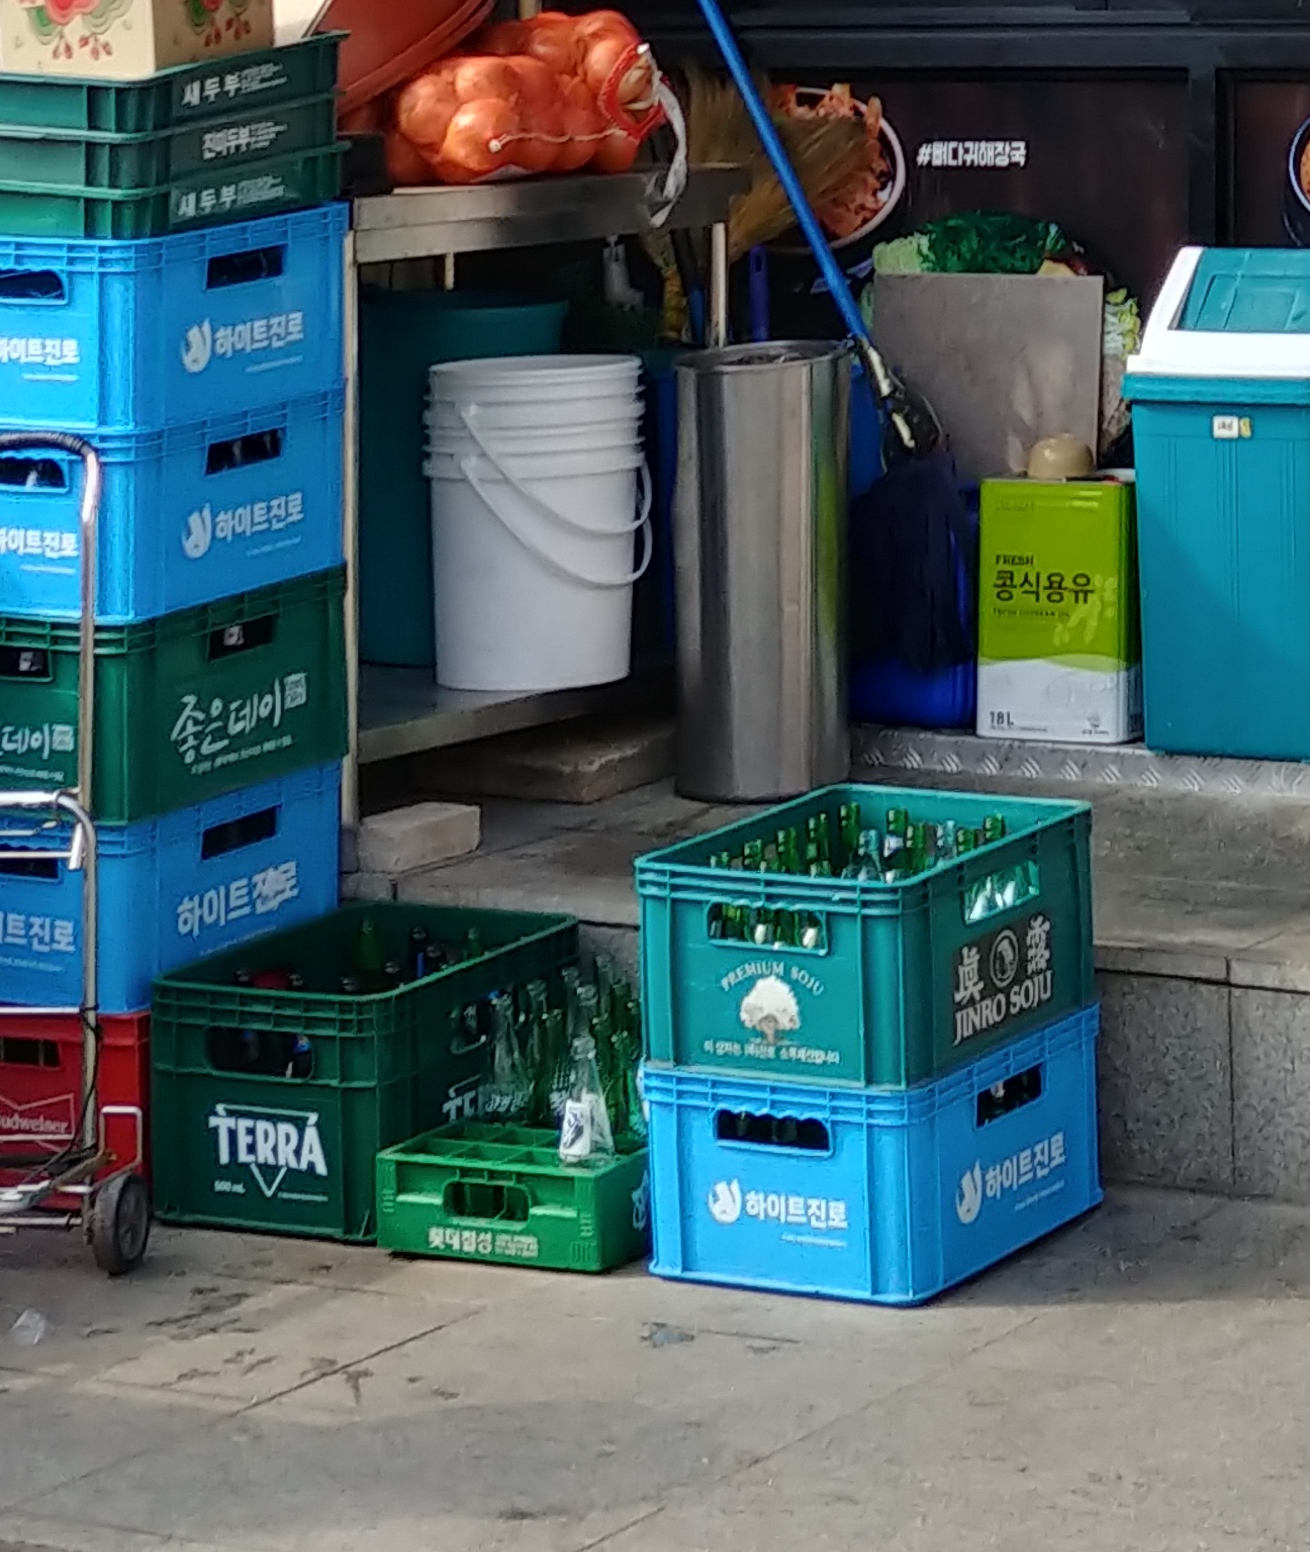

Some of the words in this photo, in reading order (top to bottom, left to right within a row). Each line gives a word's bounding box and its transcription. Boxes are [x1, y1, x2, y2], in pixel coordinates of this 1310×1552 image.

[916, 139, 1028, 169] #뼈다귀해장국
[213, 311, 304, 358] 하이트진로
[213, 491, 304, 543] 하이트진로
[992, 570, 1095, 604] 콩식용유
[0, 724, 51, 760] 데이
[170, 677, 282, 765] 좋은데이
[176, 860, 299, 939] 하이트진로
[0, 911, 76, 954] 트진로
[720, 960, 785, 992] PREMIUM
[790, 965, 825, 996] SOJU
[952, 993, 1006, 1046] JINRO
[1009, 970, 1053, 1014] SOJU
[0, 1111, 70, 1134] udweiser
[208, 1114, 328, 1177] TERRA
[984, 1131, 1066, 1199] 하이트진로
[744, 1192, 848, 1230] 하이트진로
